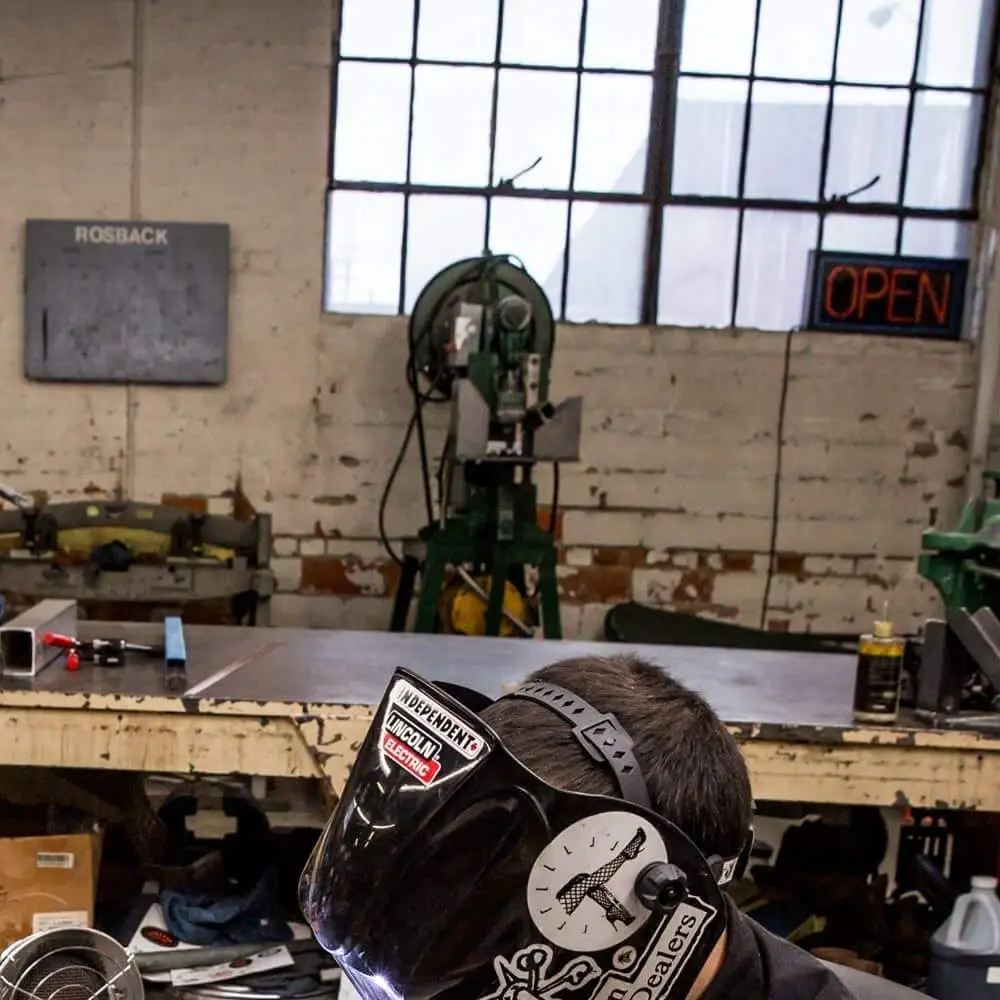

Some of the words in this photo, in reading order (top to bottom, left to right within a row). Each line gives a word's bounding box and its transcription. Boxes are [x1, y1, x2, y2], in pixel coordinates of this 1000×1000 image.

[74, 225, 169, 245] ROSBACK
[825, 265, 951, 325] OPEN
[386, 714, 438, 760] LINCOLN
[397, 686, 476, 751] INDEPENDENT
[384, 738, 430, 777] ELECTRIC
